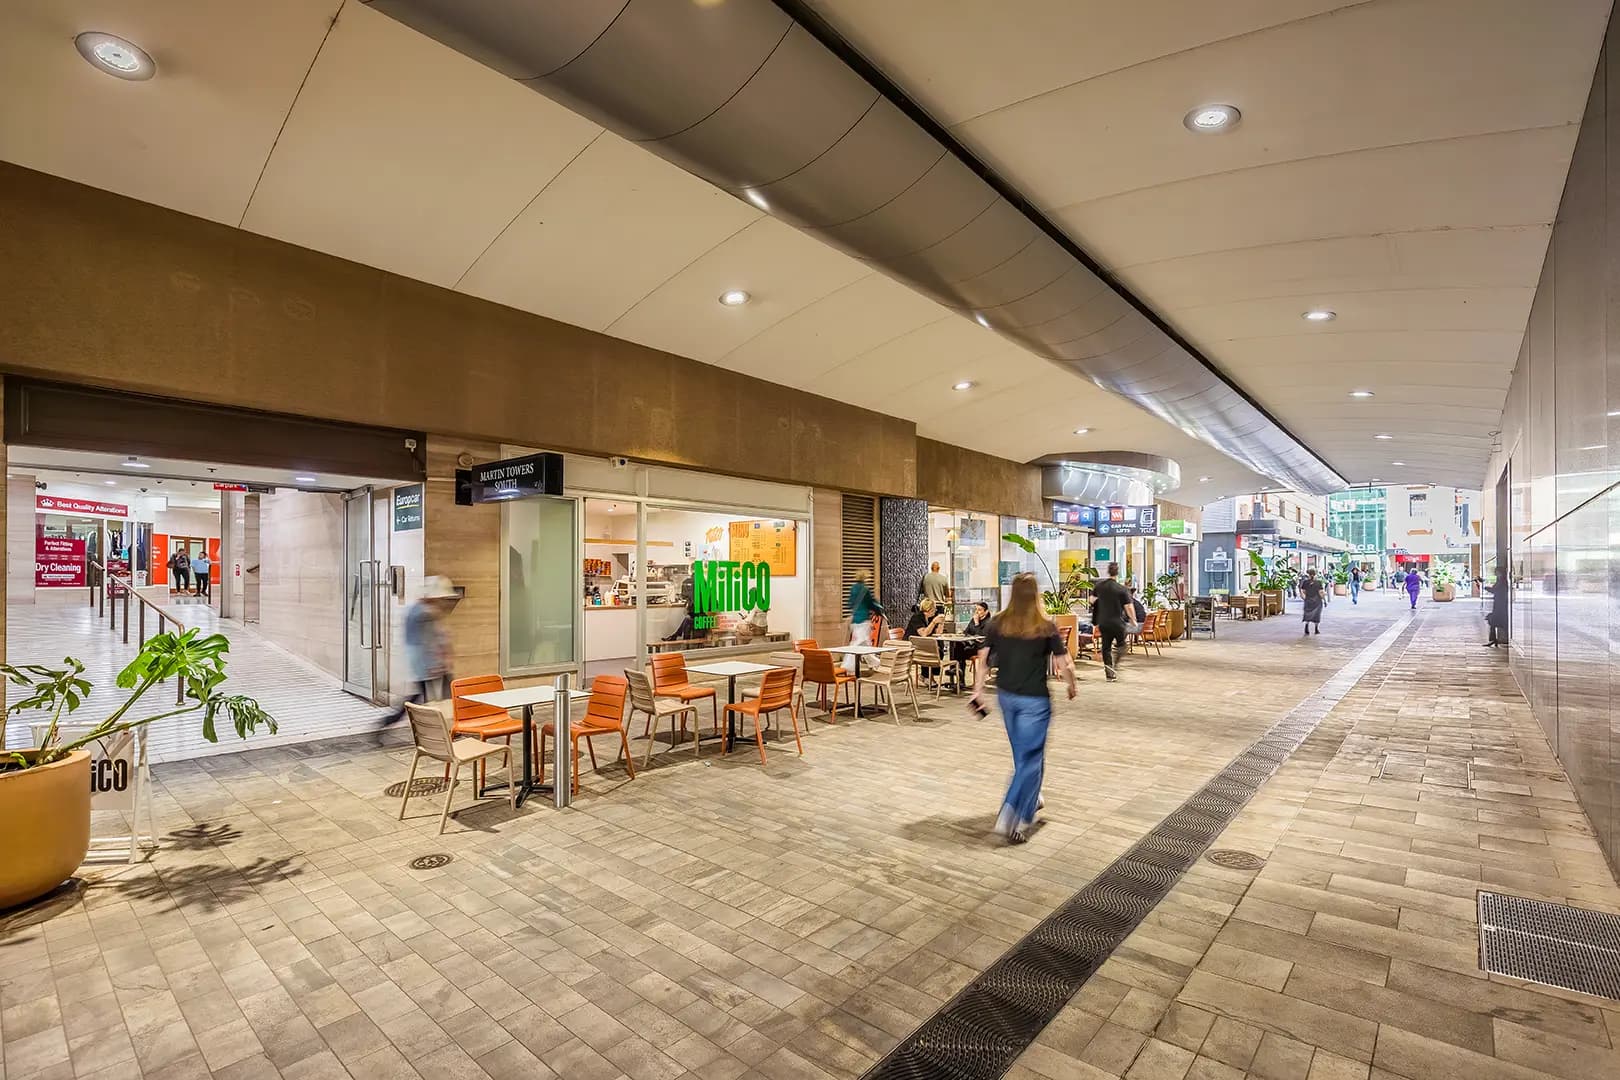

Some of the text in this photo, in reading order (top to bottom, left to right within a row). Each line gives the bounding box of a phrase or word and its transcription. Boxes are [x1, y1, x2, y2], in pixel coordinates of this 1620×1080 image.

[480, 462, 535, 482] MARTIN TOWERS
[494, 478, 517, 492] SOUTH
[396, 494, 420, 506] Europcar
[56, 501, 126, 514] Best Quality Alterations
[35, 562, 81, 574] Dry Cleaning
[91, 759, 128, 792] iCO
